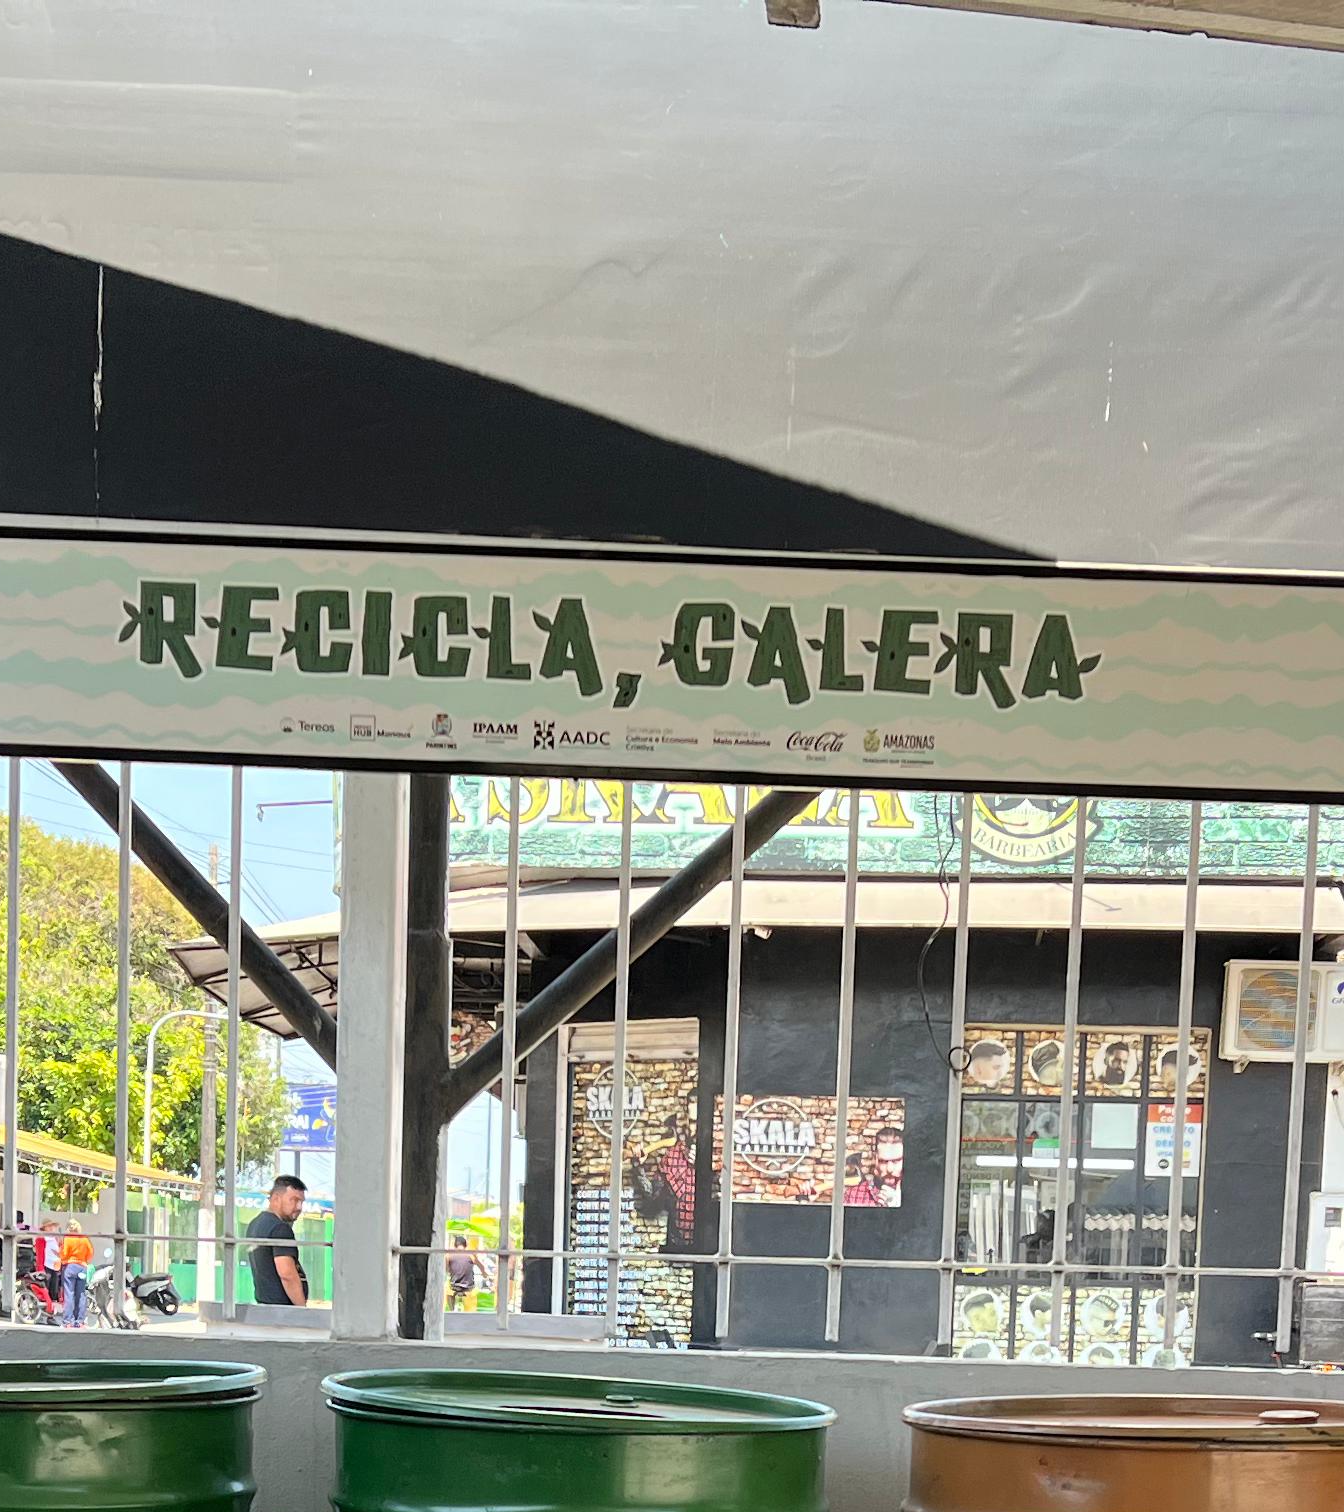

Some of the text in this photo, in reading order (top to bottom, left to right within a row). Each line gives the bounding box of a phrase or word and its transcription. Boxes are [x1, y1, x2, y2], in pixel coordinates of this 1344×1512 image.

[122, 580, 1102, 708] RECICLA, GALERA
[298, 720, 335, 733] Tereos
[473, 723, 518, 735] IPAAM
[559, 731, 610, 746] AADC
[883, 734, 935, 750] AMAZONAS
[973, 828, 1077, 858] BARBEARIA
[586, 1086, 644, 1111] SKLA
[734, 1119, 815, 1147] SKALA
